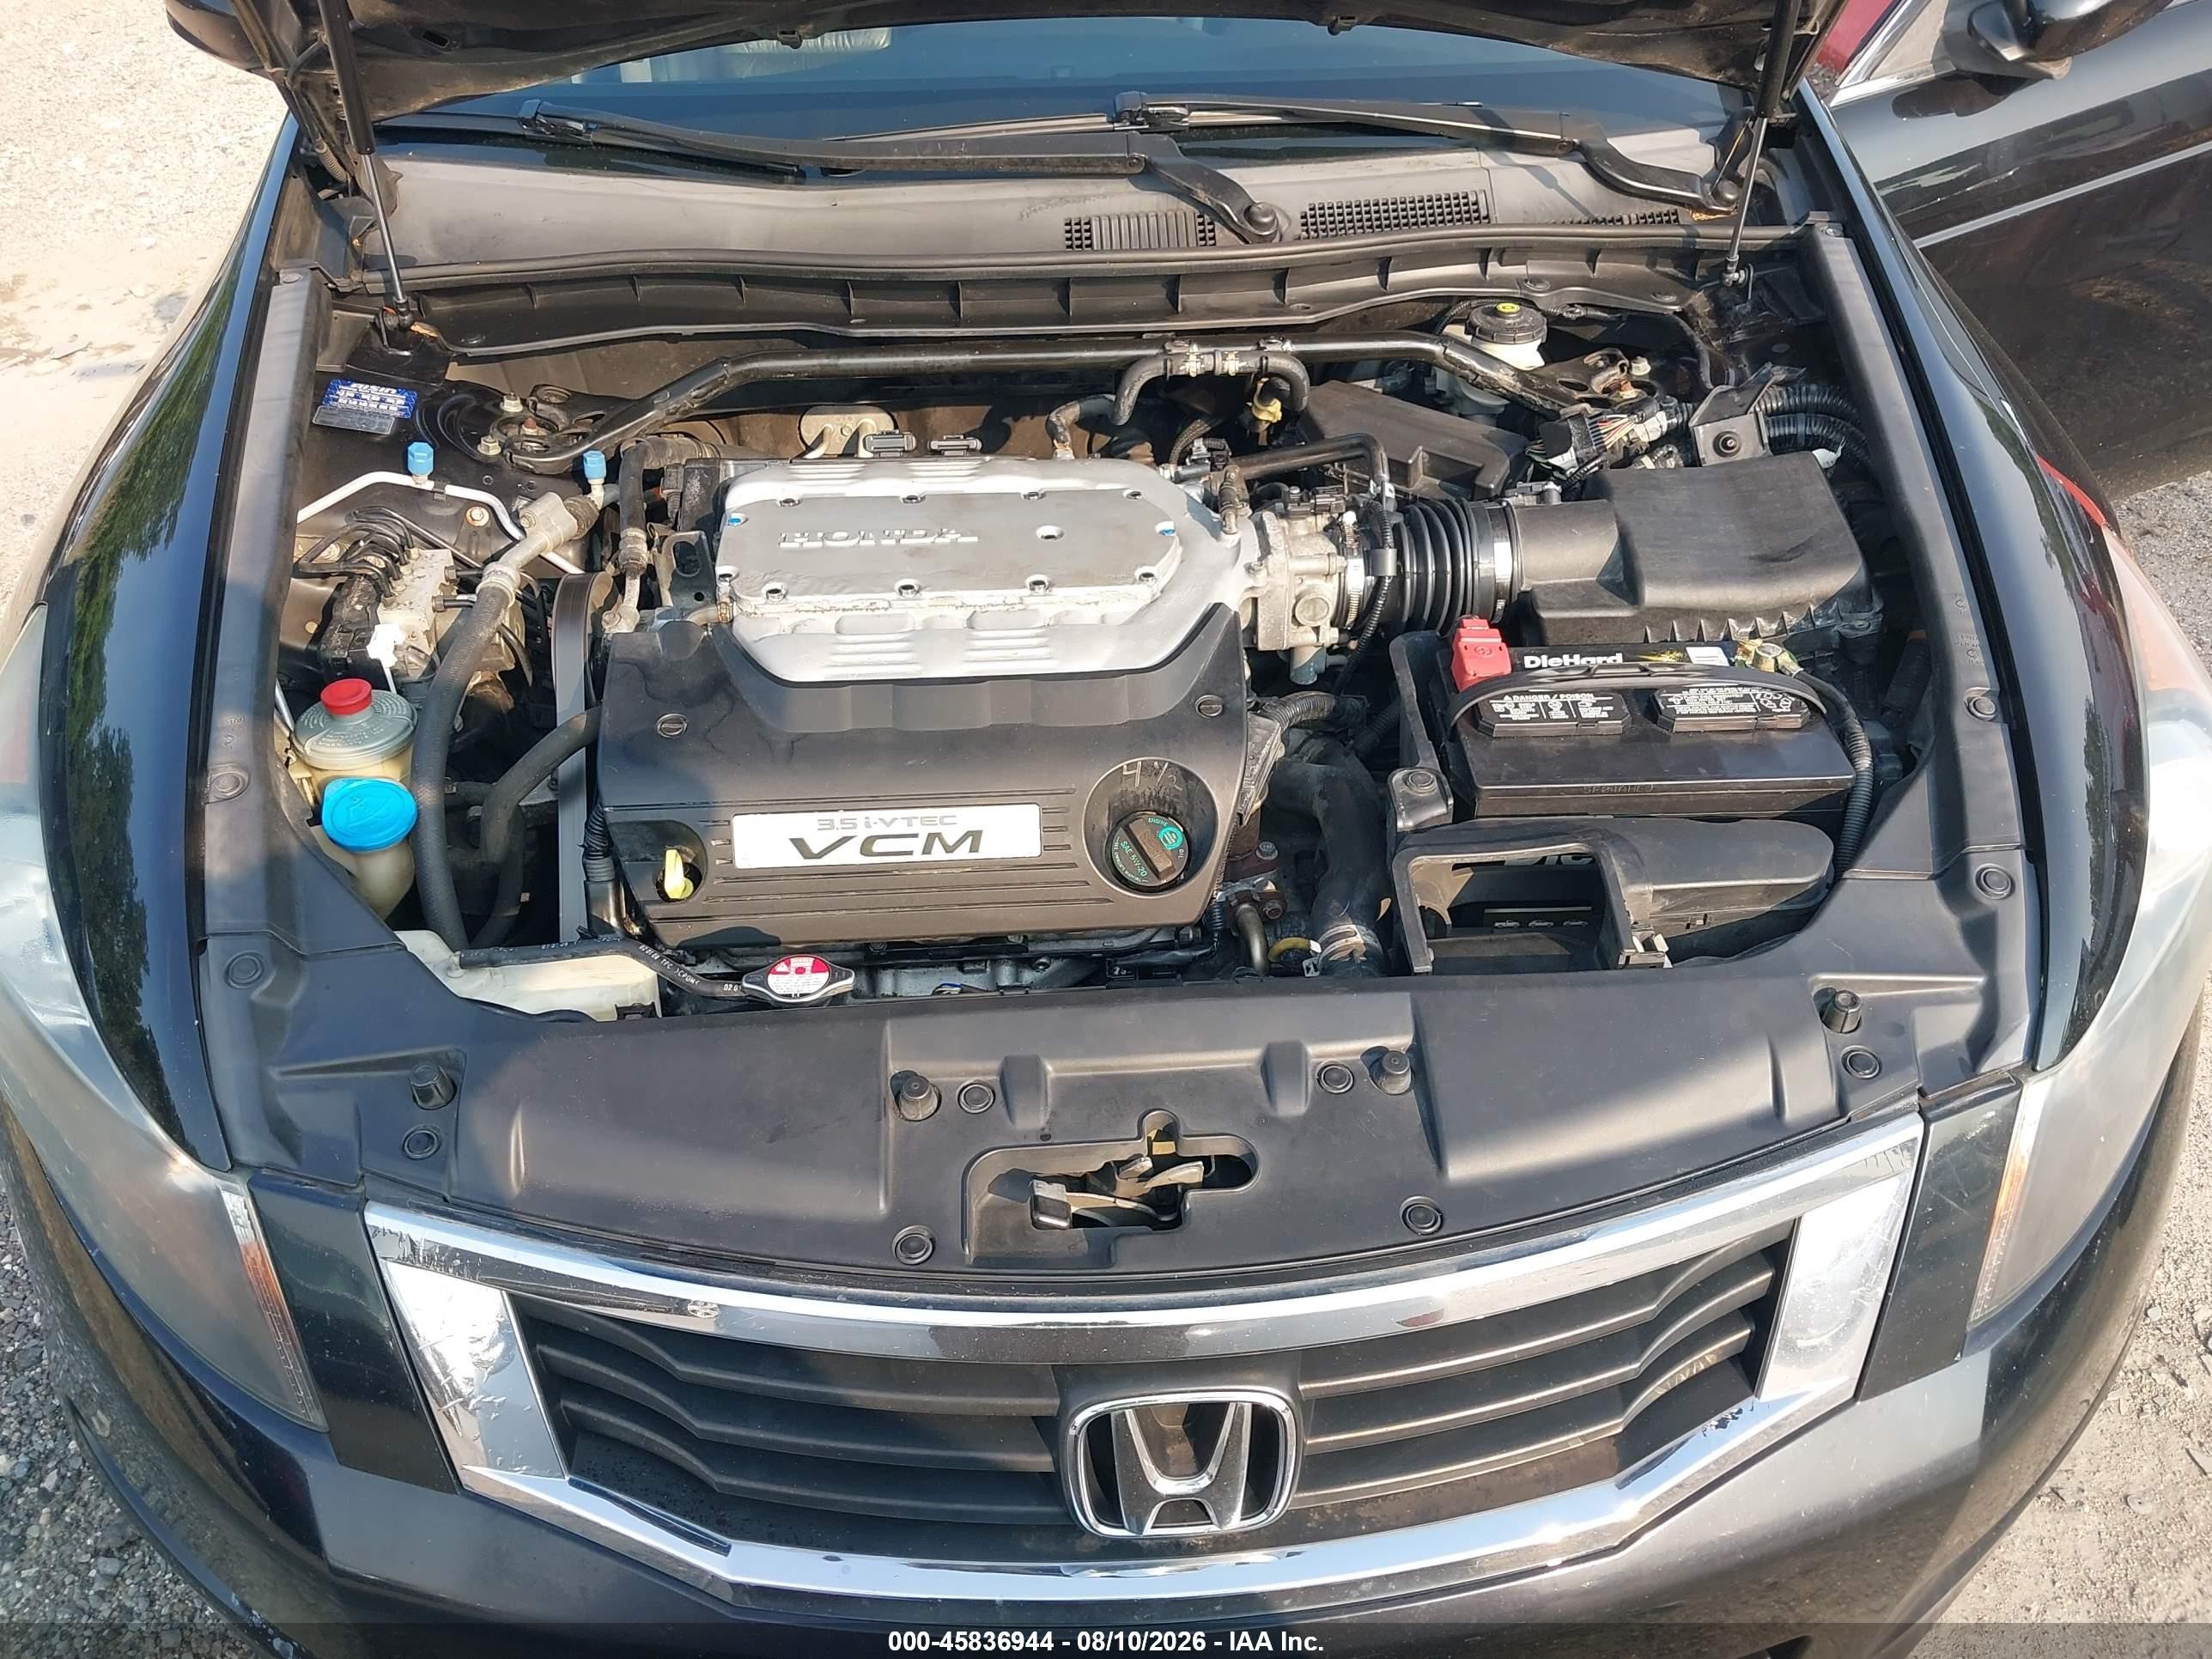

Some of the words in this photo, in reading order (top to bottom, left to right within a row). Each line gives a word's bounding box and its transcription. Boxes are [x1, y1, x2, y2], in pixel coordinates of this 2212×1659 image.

[779, 527, 979, 549] HONDA
[1523, 653, 1623, 669] DieHard
[817, 817, 858, 831] 3.5
[787, 830, 983, 860] VCM
[1120, 841, 1133, 855] SAE
